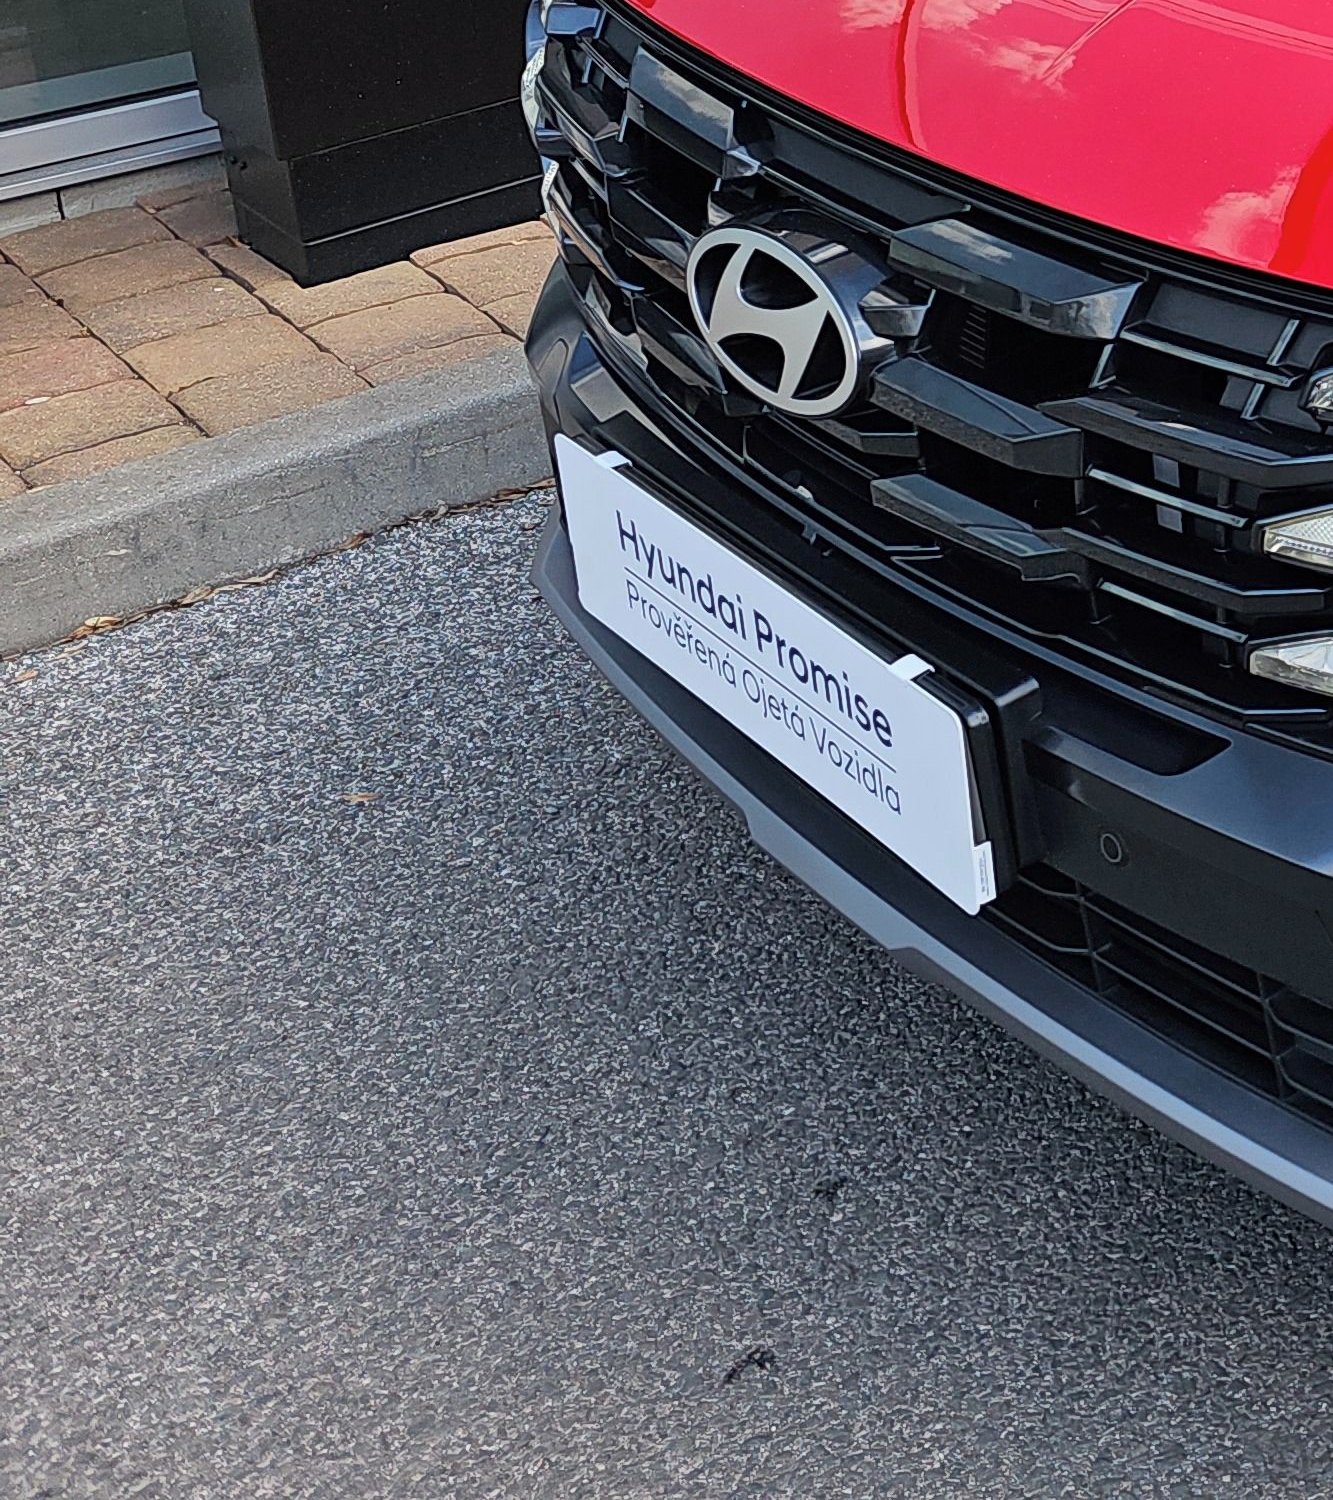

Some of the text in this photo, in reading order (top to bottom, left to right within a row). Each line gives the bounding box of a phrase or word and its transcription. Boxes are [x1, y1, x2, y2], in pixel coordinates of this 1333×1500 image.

[616, 510, 893, 748] Hyundai Promise
[626, 579, 901, 815] Prověřená Ojetá Vozidla
